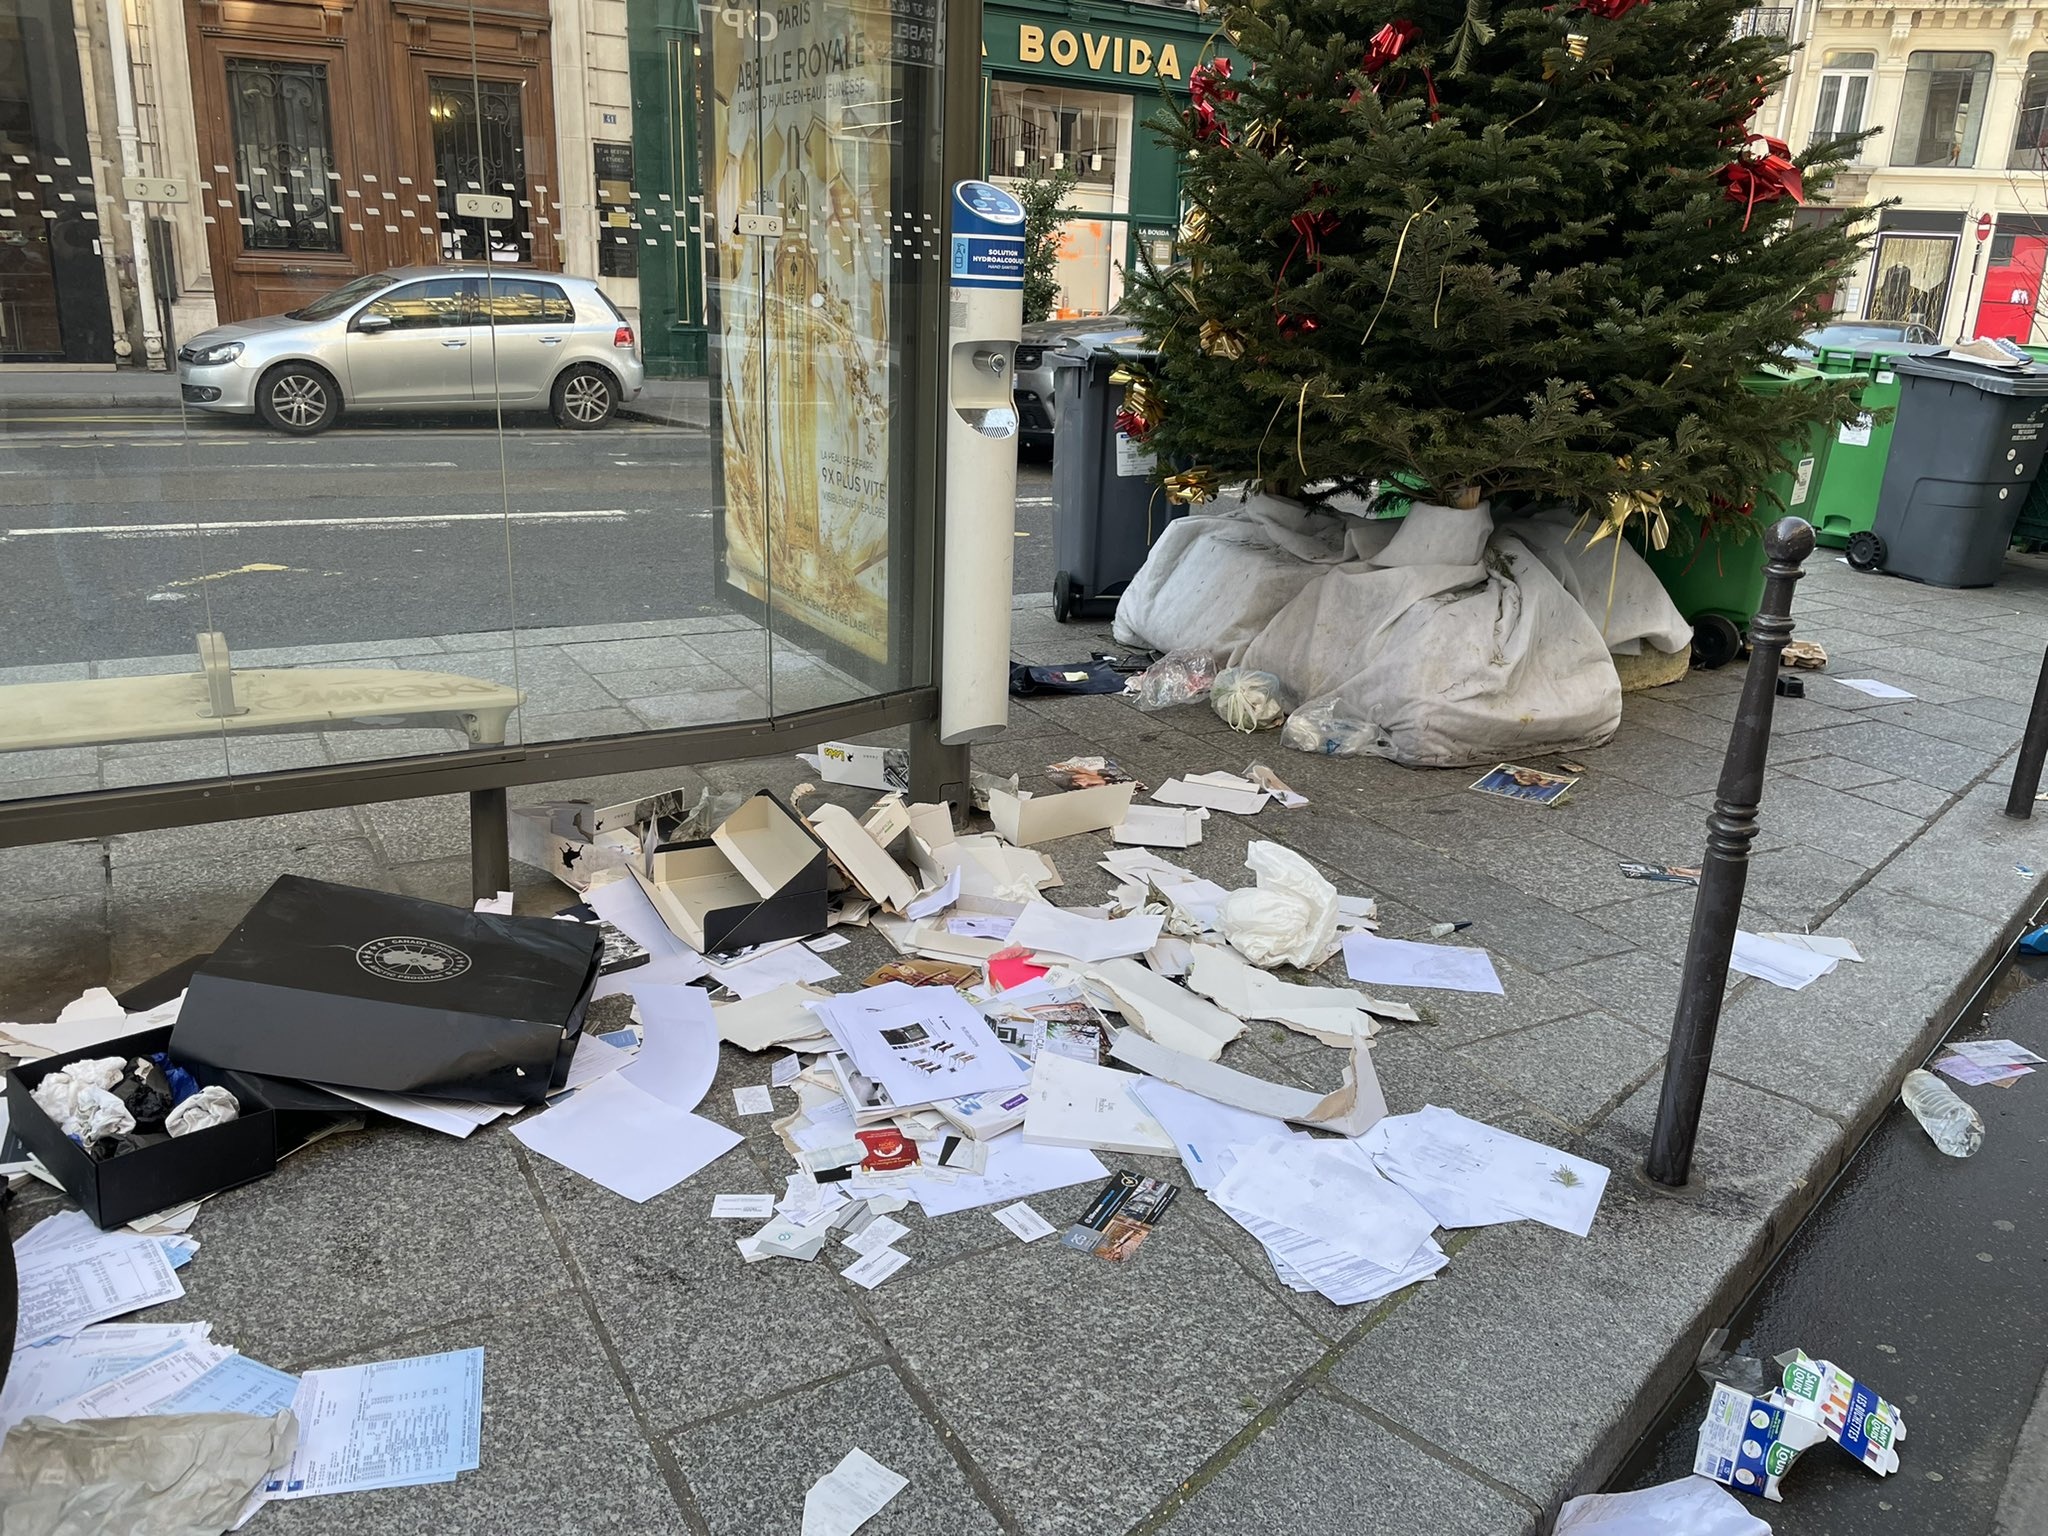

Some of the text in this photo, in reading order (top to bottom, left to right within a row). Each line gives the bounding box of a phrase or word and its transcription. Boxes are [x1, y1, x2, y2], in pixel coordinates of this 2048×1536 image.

[777, 2, 811, 32] PARIS
[797, 32, 866, 81] ROYALE
[1019, 24, 1181, 80] BOVIDA
[988, 249, 1019, 257] SOLUTION
[836, 471, 861, 492] PLUS
[863, 478, 887, 500] VITE
[1791, 1367, 1806, 1393] LOUIS
[1801, 1373, 1817, 1399] SAINT
[1856, 1392, 1868, 1407] LES
[1871, 1419, 1882, 1442] LOUIS
[1879, 1423, 1891, 1447] SAINT
[1775, 1446, 1792, 1475] LOUIS
